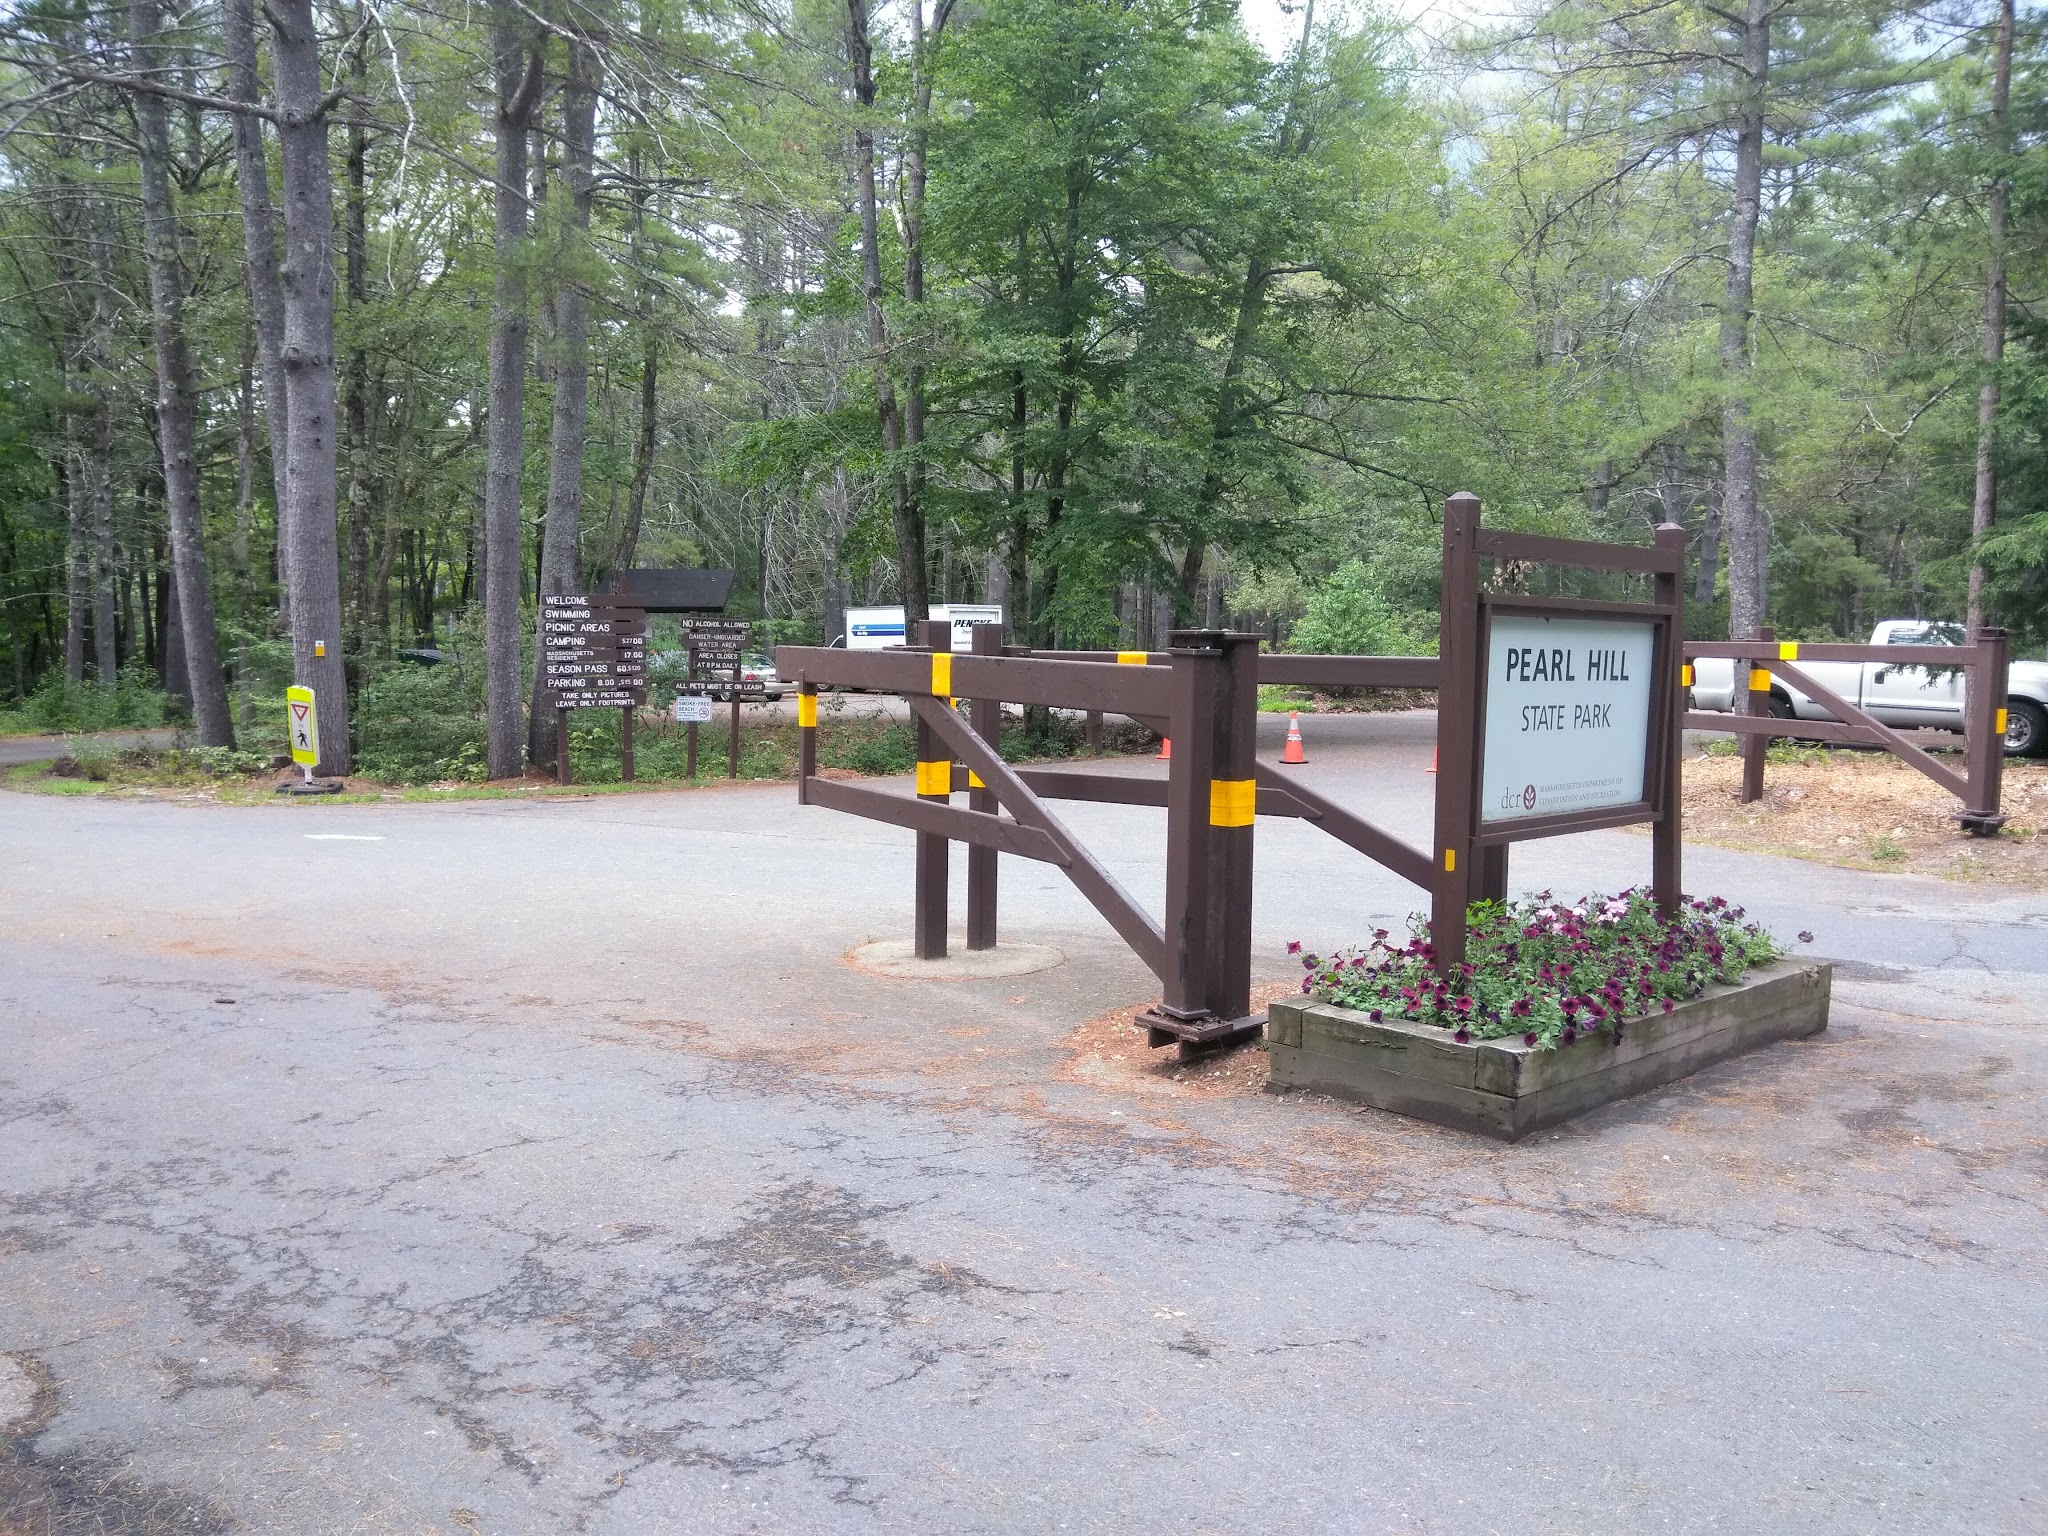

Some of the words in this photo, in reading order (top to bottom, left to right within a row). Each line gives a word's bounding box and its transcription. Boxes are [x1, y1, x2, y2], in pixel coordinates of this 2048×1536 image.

[546, 596, 588, 605] WELCOME
[545, 610, 590, 619] SWIMMING
[546, 623, 576, 632] PICNIC
[580, 624, 610, 632] AREAS
[682, 620, 694, 628] NO
[546, 637, 586, 646] CAMPING
[624, 651, 644, 659] 17.00
[547, 665, 582, 674] SEASON
[584, 664, 608, 673] PASS
[1506, 648, 1575, 682] PEARL
[1587, 649, 1629, 682] HILL
[548, 679, 586, 688] PARKING
[1521, 704, 1565, 732] STATE
[1574, 704, 1612, 730] PARK
[1540, 782, 1582, 792] MASSACHUSETTS
[1582, 778, 1614, 788] DEPARTMENT
[1500, 787, 1522, 809] dcr
[1538, 794, 1578, 806] CONSERVATION
[1590, 790, 1621, 800] RECREATION
